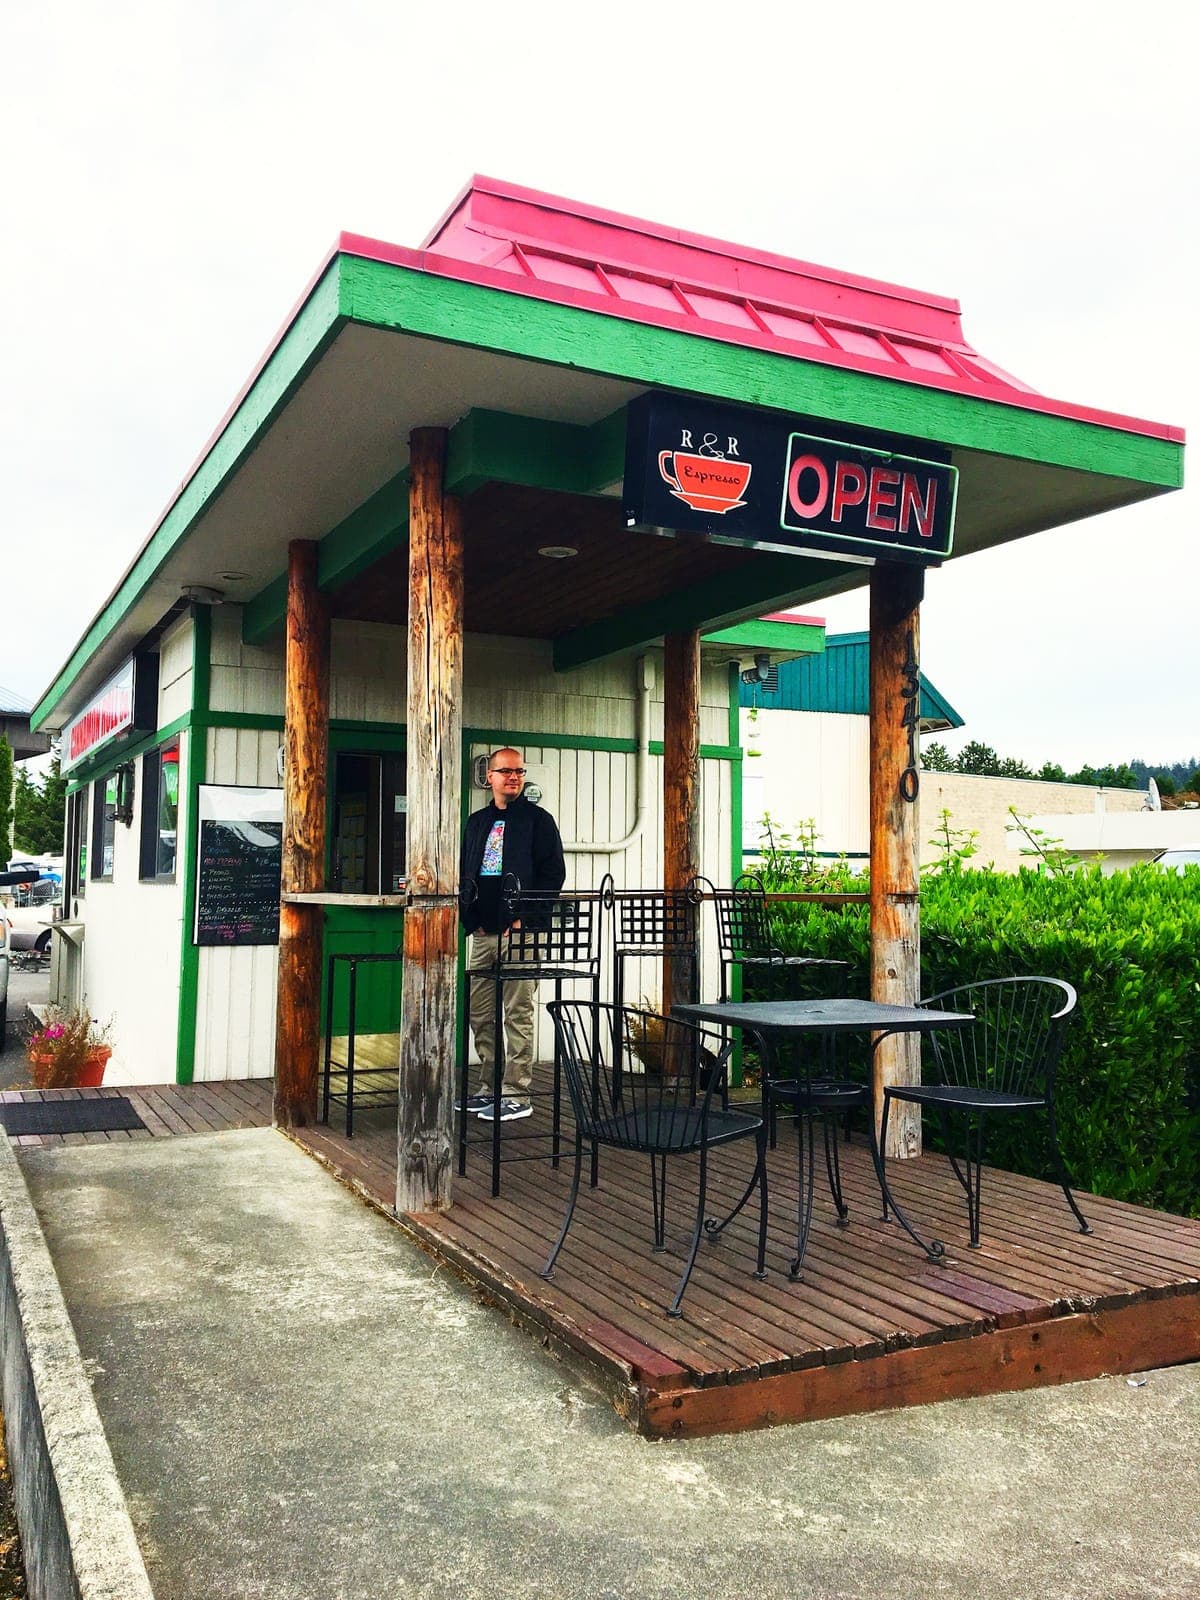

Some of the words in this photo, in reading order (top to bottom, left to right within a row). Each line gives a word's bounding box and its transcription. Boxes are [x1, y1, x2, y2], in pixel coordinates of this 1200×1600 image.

[681, 430, 694, 449] R
[698, 433, 725, 461] &
[726, 436, 740, 456] R
[683, 465, 741, 486] Espresso
[788, 453, 938, 538] OPEN
